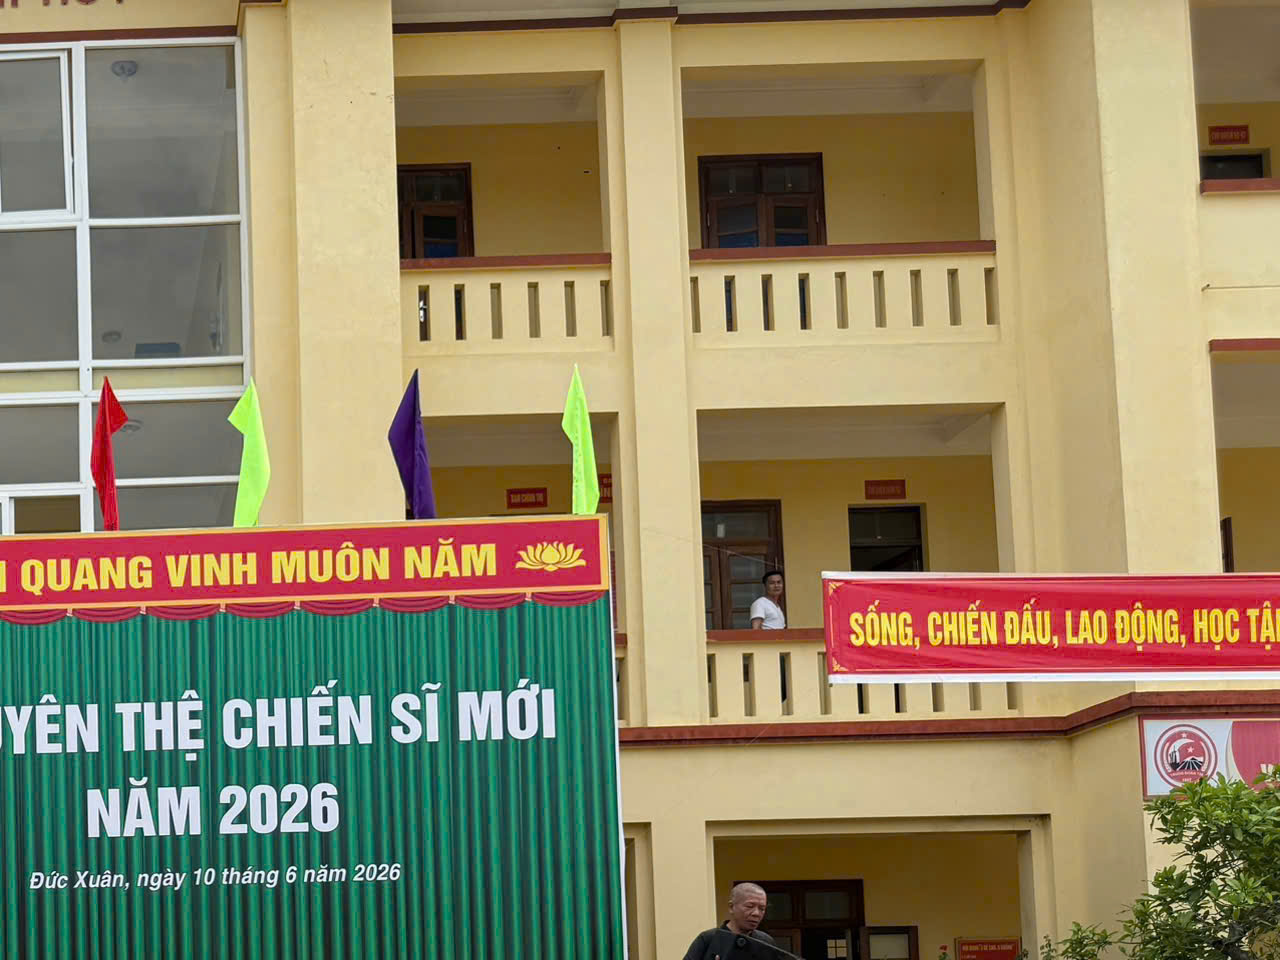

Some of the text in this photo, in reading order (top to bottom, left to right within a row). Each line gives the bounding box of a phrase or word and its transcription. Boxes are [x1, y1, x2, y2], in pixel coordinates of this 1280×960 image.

[21, 556, 152, 595] QUANG
[166, 553, 256, 587] VINH
[272, 542, 389, 583] MUÔN
[405, 538, 496, 578] NĂM
[850, 600, 920, 649] SỐNG,
[928, 600, 997, 645] CHIẾN
[1004, 599, 1058, 648] ĐẤU,
[1066, 610, 1108, 644] LAO
[1115, 603, 1186, 651] ĐỘNG,
[1194, 609, 1239, 650] HỌC
[115, 690, 204, 760] THỆ
[223, 680, 372, 748] CHIẾN
[391, 683, 441, 743] SĨ
[458, 679, 555, 740] MỚI
[87, 777, 339, 837] NĂM 2026
[30, 864, 400, 890] Đức Xuân, ngày 10 tháng 6 năm 2026
